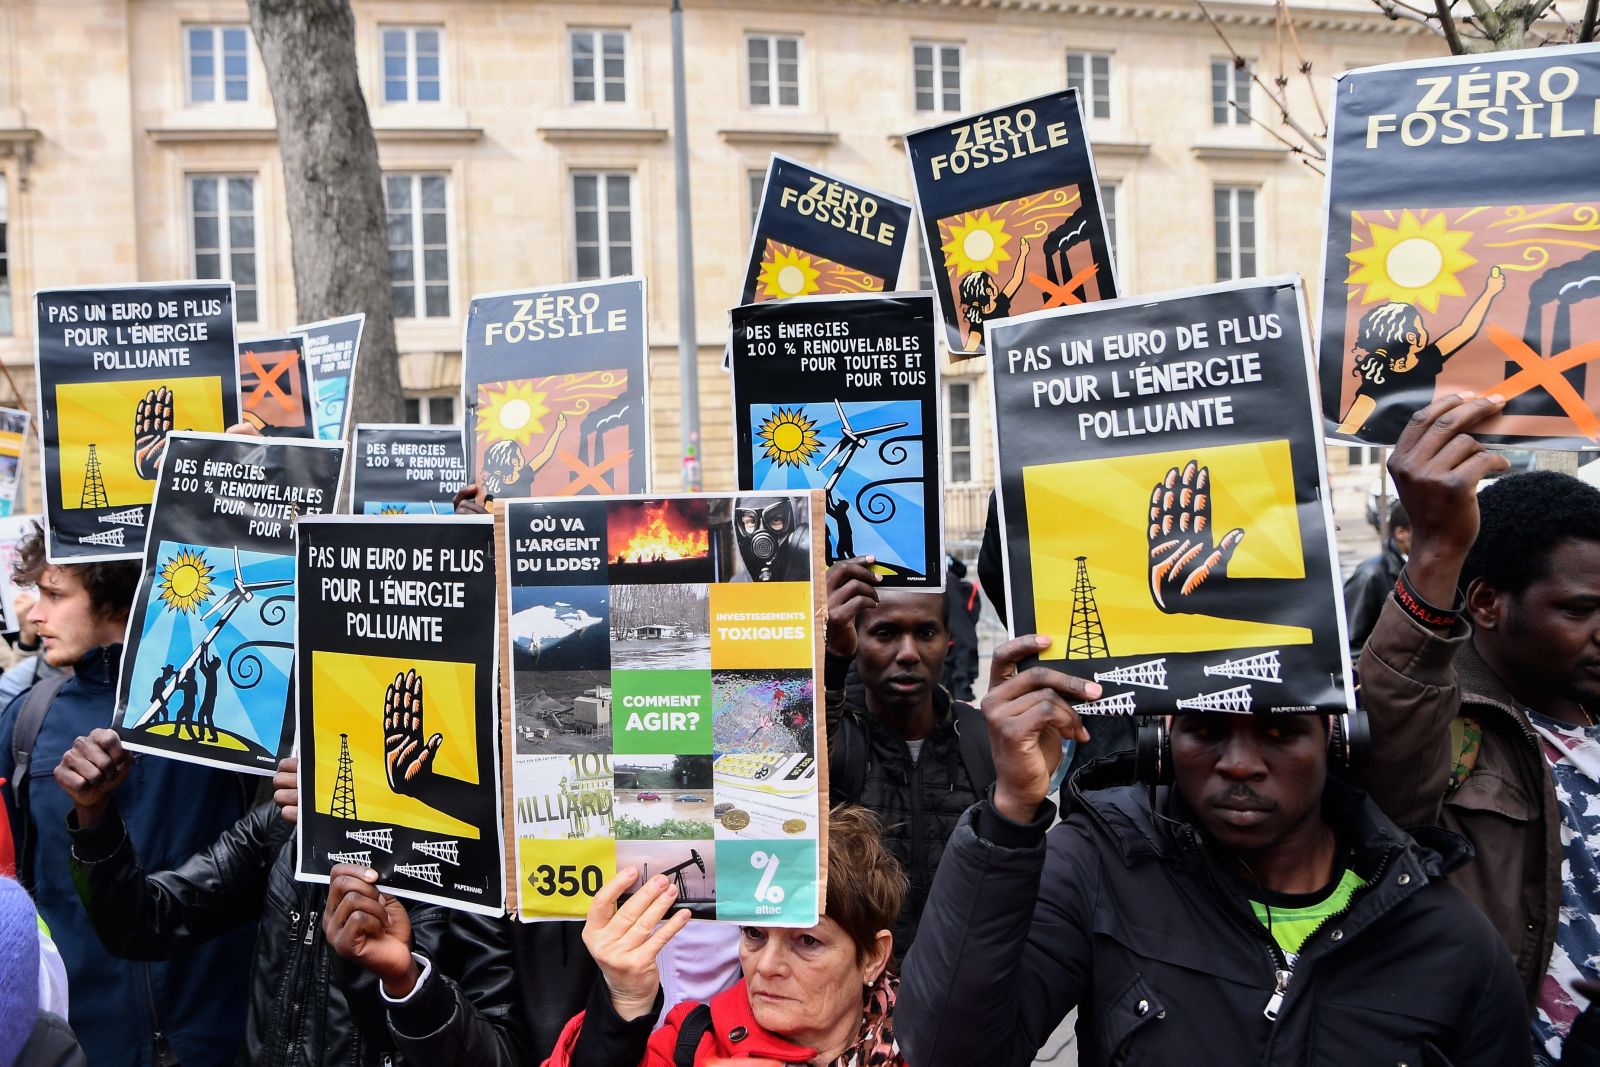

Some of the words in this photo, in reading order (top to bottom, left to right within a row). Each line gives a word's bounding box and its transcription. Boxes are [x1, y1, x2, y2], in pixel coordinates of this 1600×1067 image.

[1416, 66, 1579, 112] ZÉRO
[951, 109, 1036, 152] ZÉRO
[1366, 98, 1600, 149] FOSSIL
[930, 121, 1069, 181] FOSSILE
[807, 176, 878, 219] ZÉRO
[780, 186, 896, 246] FOSSILE
[49, 305, 78, 323] PAS
[84, 304, 106, 322] UN
[112, 303, 152, 321] EURO
[158, 301, 178, 319] DE
[184, 300, 222, 317] PLUS
[512, 293, 600, 322] ZÉRO
[64, 327, 109, 347] POUR
[116, 322, 208, 345] L'ÉNERGIE
[485, 309, 626, 346] FOSSILE
[746, 325, 771, 340] DES
[778, 322, 849, 339] ÉNERGIES
[747, 342, 776, 356] 100
[784, 343, 796, 355] %
[804, 336, 919, 355] RENOUVELABLES
[1007, 345, 1051, 374] PAS
[1060, 340, 1094, 367] UN
[1103, 329, 1166, 361] EURO
[1176, 322, 1209, 351] DE
[1217, 313, 1282, 346] PLUS
[93, 347, 190, 370] POLLUANTE
[801, 357, 836, 372] POUR
[844, 354, 897, 370] TOUTES
[904, 353, 922, 368] ET
[846, 373, 882, 388] POUR
[890, 370, 926, 386] TOUS
[1032, 374, 1101, 408] POUR
[1111, 352, 1262, 399] L'ÉNERGIE
[1078, 396, 1234, 440] POLLUANTE
[366, 443, 386, 455] DES
[391, 441, 446, 456] ÉNERGIES
[174, 458, 197, 475] DES
[202, 458, 266, 480] ÉNERGIES
[366, 456, 389, 467] 100
[395, 458, 404, 468] %
[409, 456, 466, 468] RENOUVEL
[406, 469, 434, 480] POUR
[440, 469, 466, 480] TOUT
[171, 477, 199, 493] 100
[204, 481, 214, 494] %
[220, 480, 323, 504] RENOUVELABLES
[213, 498, 246, 516] POUR
[249, 520, 282, 538] POUR
[530, 515, 556, 532] OÙ
[560, 518, 585, 531] VA
[516, 537, 600, 552] L'ARGENT
[308, 546, 335, 568] PAS
[340, 547, 360, 569] UN
[366, 547, 407, 571] EURO
[412, 549, 433, 572] DE
[439, 549, 484, 573] PLUS
[517, 558, 541, 572] DU
[546, 557, 600, 571] LDDS?
[321, 577, 362, 603] POUR
[369, 575, 465, 608] L'ÉNERGIE
[346, 612, 443, 642] POLLUANTE
[716, 612, 805, 621] INVESTISSEMENTS
[718, 627, 805, 640] TOXIQUES
[622, 695, 701, 707] COMMENT
[1271, 705, 1317, 713] PAPERHAND
[625, 711, 700, 731] AGIR?
[536, 864, 603, 897] 350
[755, 905, 782, 915] attac
